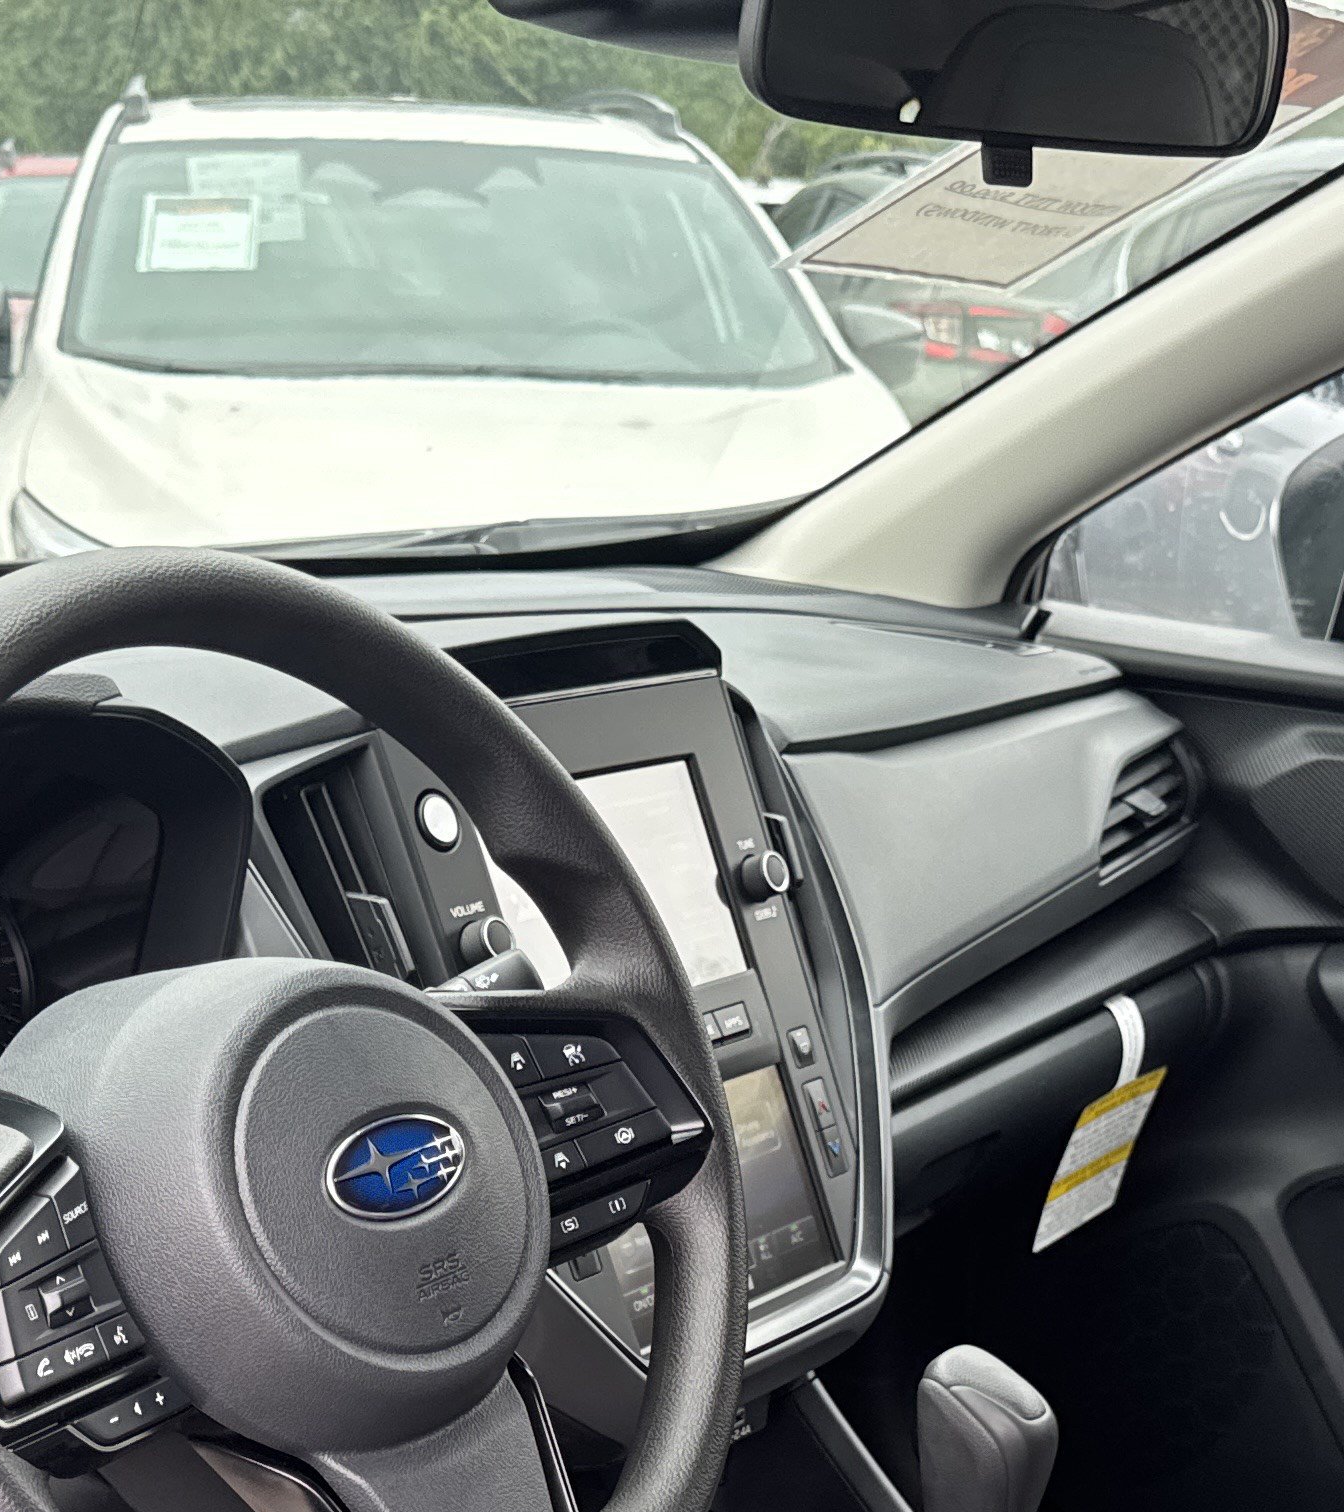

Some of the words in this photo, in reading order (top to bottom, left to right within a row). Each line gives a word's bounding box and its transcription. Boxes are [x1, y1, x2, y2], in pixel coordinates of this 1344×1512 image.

[449, 900, 486, 919] VOLUME
[61, 1200, 90, 1225] SOURCE
[419, 1252, 467, 1280] SRS
[419, 1271, 471, 1302] AIRBAG
